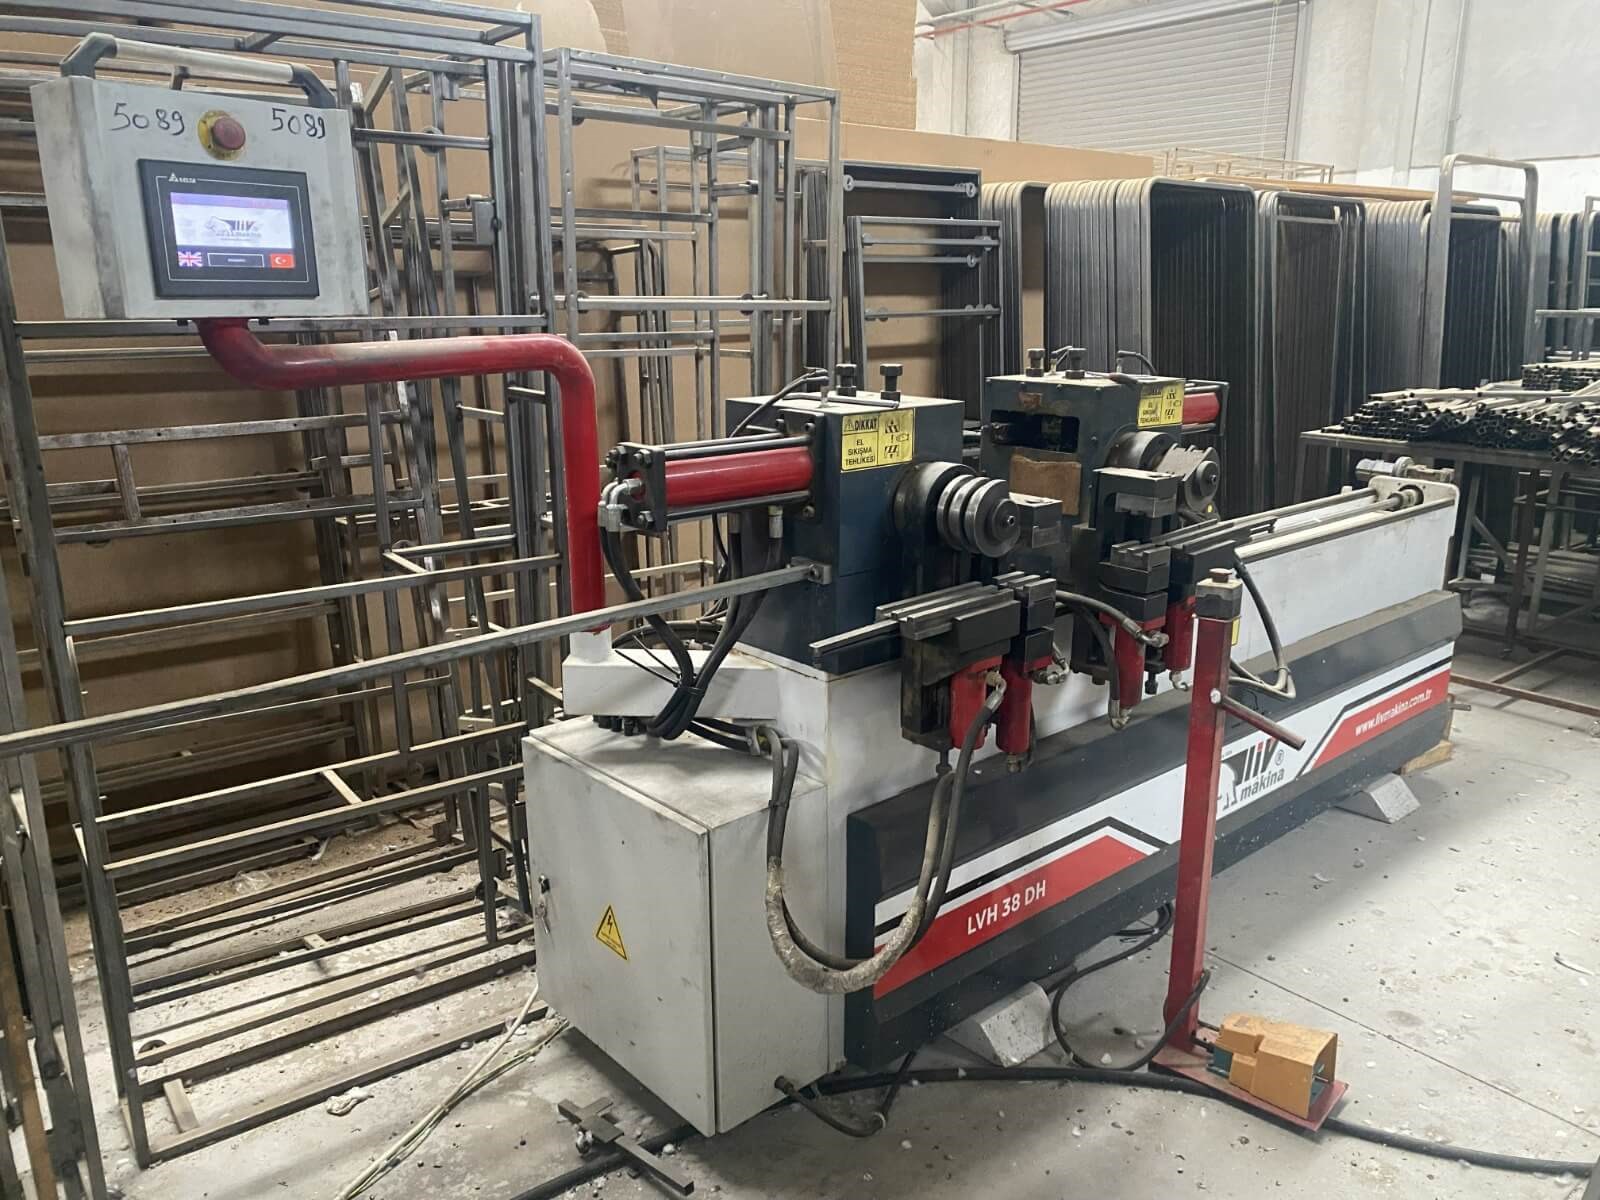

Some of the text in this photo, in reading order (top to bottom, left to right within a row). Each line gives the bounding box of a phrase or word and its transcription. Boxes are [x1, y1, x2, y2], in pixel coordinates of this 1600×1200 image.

[111, 102, 185, 136] 5089
[271, 107, 326, 139] 5089
[856, 438, 865, 446] EL
[1240, 768, 1285, 802] makina
[967, 879, 1047, 935] LVH 38 DH
